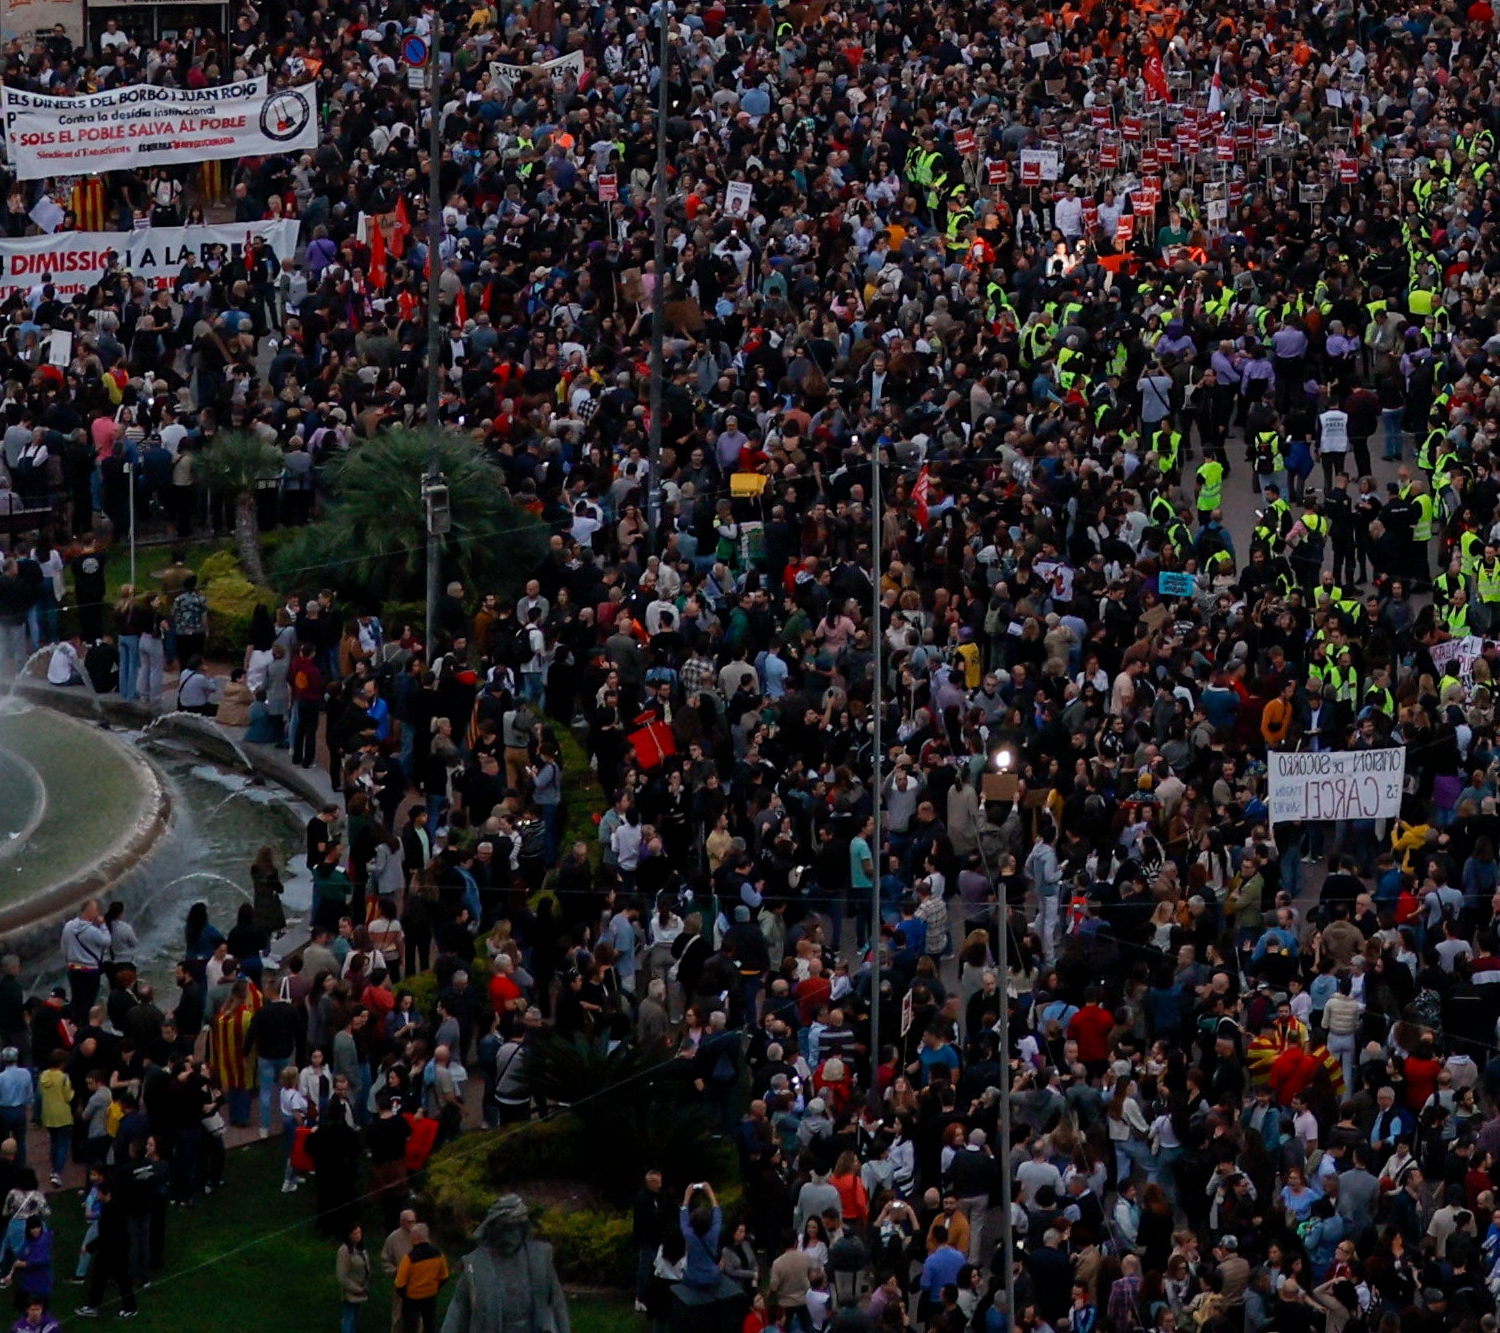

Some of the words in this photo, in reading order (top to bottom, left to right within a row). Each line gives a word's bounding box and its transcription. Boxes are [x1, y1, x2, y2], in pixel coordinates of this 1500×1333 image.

[8, 93, 30, 106] ELS
[33, 96, 87, 109] DINERS
[90, 96, 116, 108] DEL
[119, 88, 168, 103] BORBÓ
[177, 90, 219, 102] JUAN
[59, 116, 95, 125] Contra
[97, 112, 108, 121] la
[111, 108, 151, 120] desídia
[154, 105, 216, 117] institucional
[20, 133, 55, 146] SOLS
[59, 130, 75, 143] EL
[78, 124, 125, 141] POBLE
[128, 121, 174, 137] SALVA
[179, 120, 196, 133] AL
[200, 116, 246, 130] POBLE
[11, 246, 112, 276] DIMISSIÓ
[139, 248, 156, 268] A
